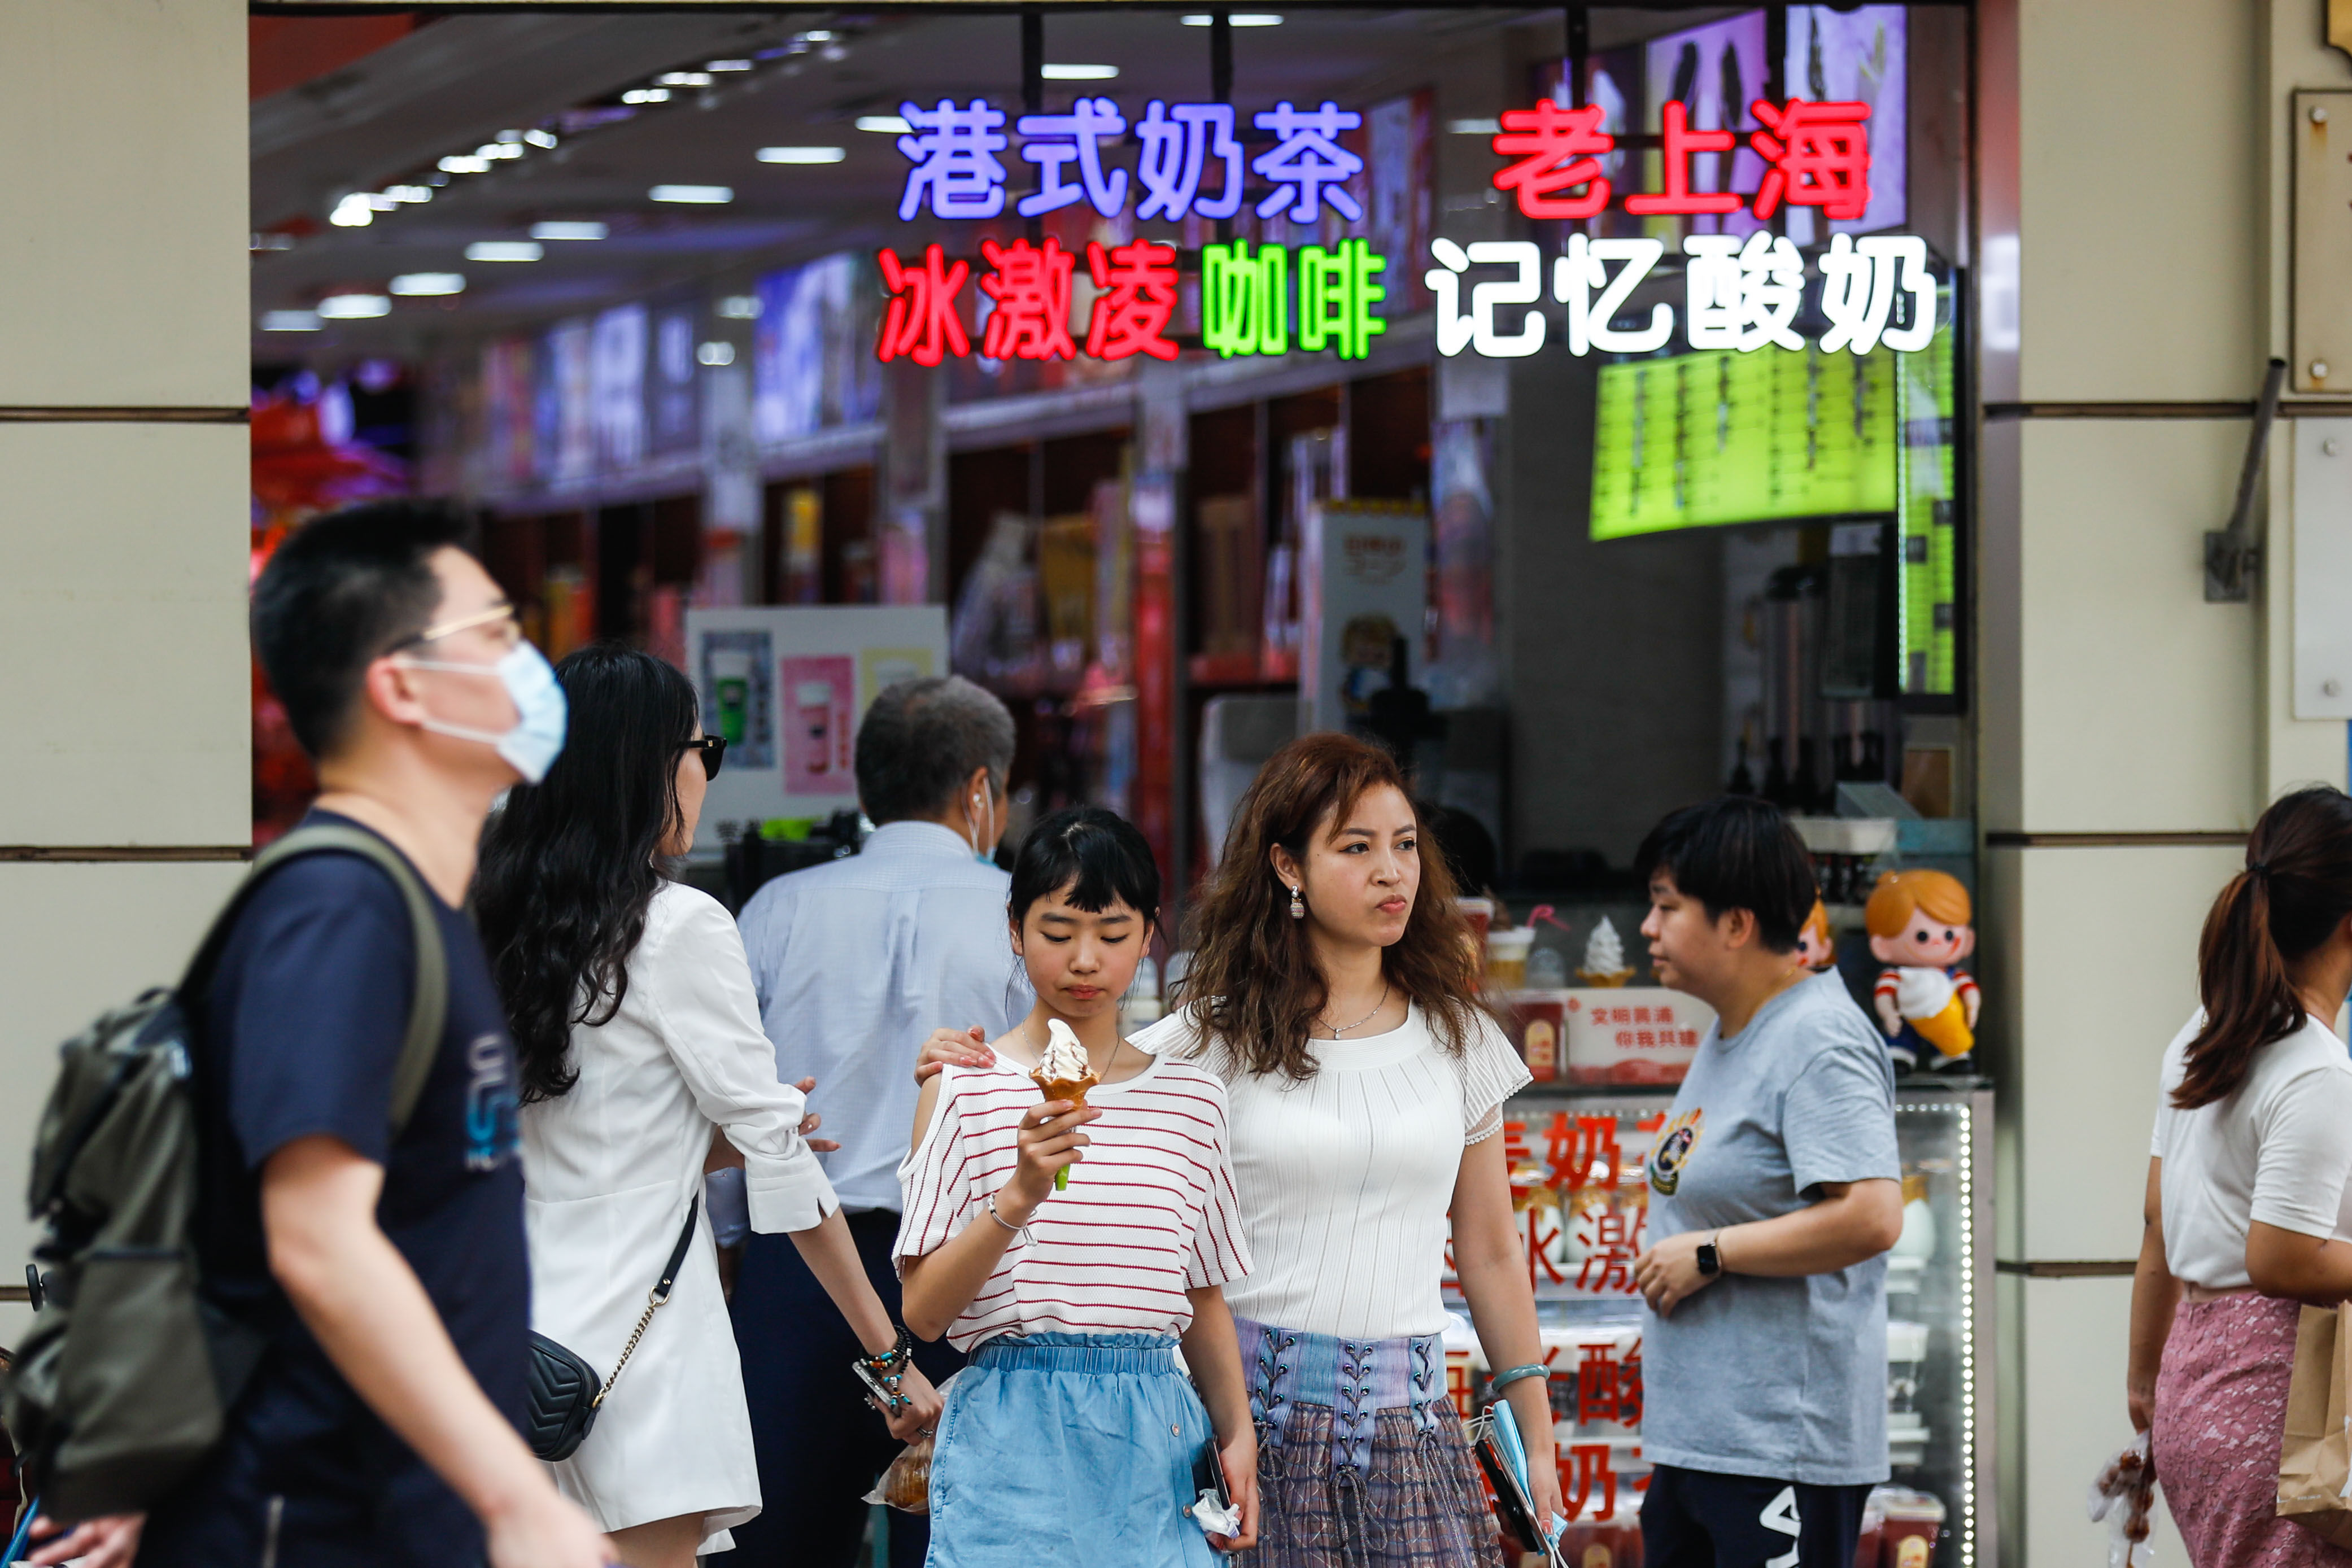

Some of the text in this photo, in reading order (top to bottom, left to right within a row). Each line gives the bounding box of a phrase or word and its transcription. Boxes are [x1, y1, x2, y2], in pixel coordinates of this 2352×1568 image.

[897, 97, 1364, 222] 港式奶茶
[1492, 97, 1874, 220] 老上海
[878, 237, 1387, 367] 冰激凌 咖啡
[1424, 231, 1938, 358] 记忆酸奶
